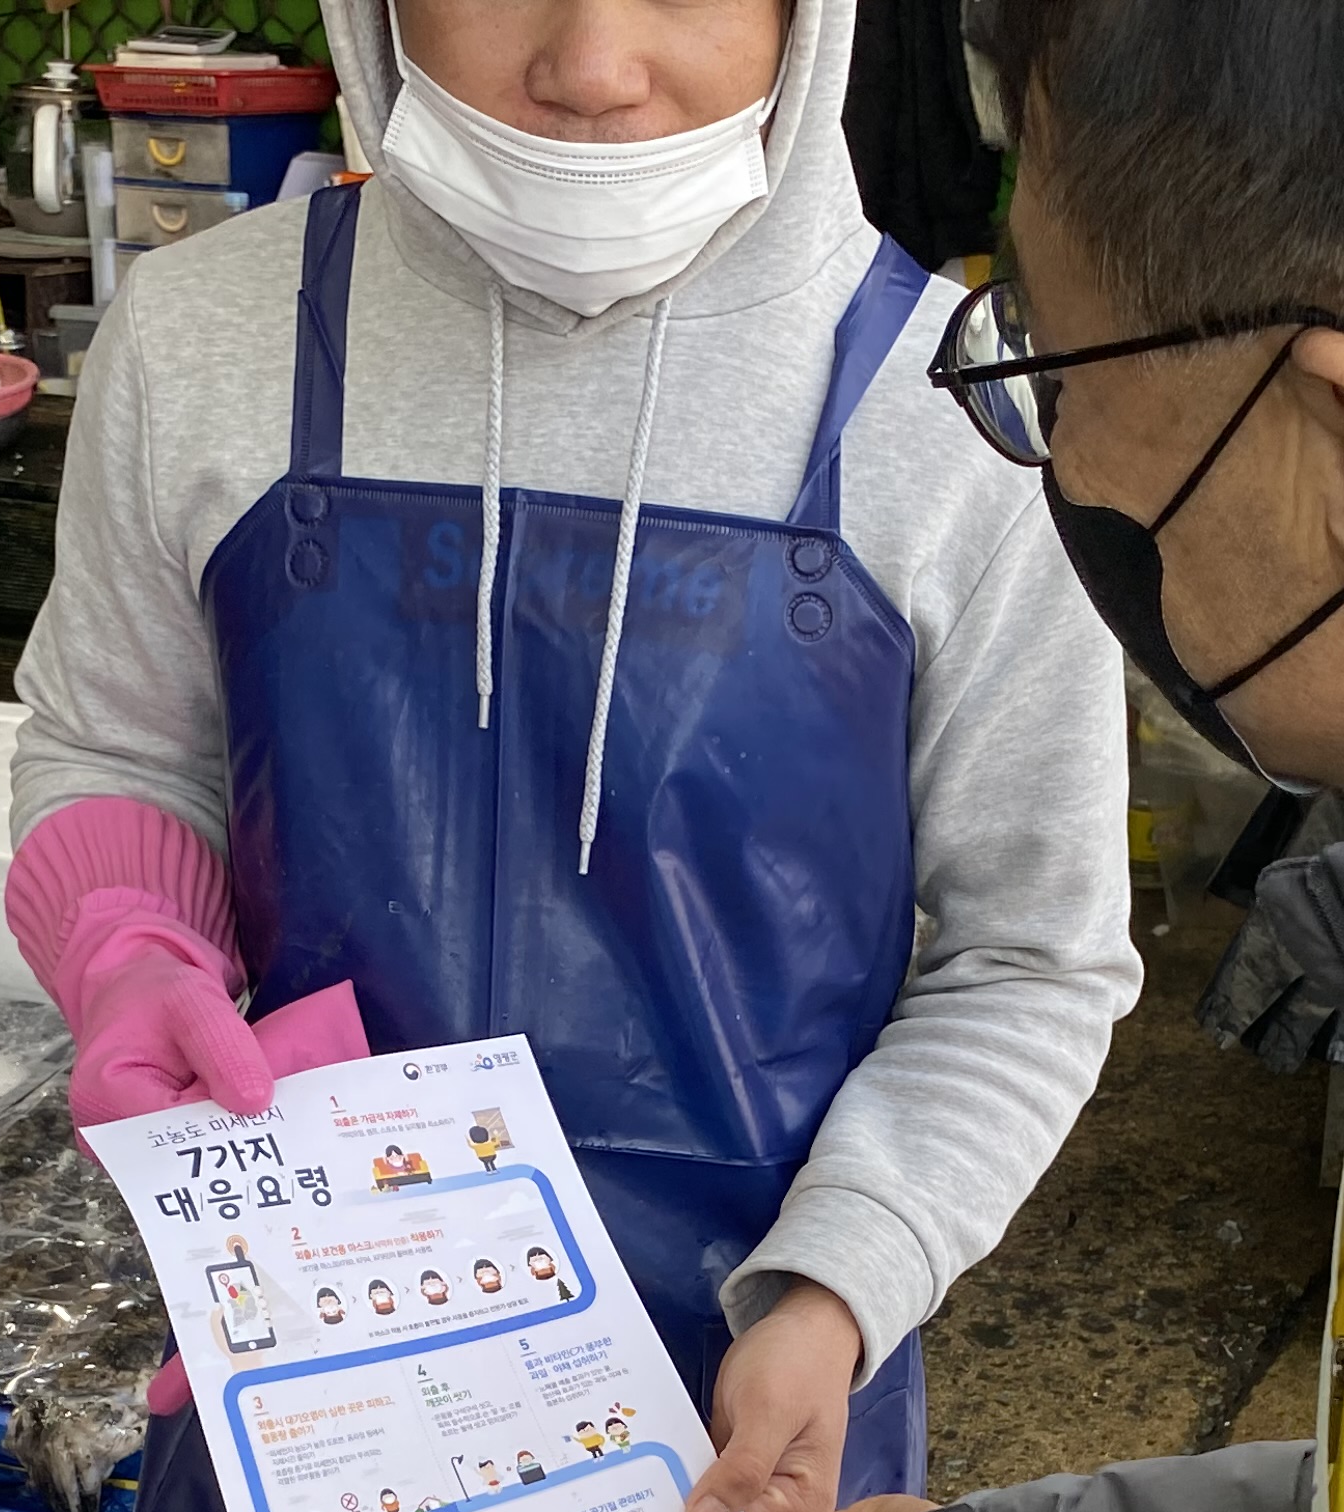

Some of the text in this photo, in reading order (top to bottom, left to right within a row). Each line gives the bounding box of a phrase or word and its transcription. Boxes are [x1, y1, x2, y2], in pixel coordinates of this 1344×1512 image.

[330, 1095, 339, 1108] 1
[147, 1105, 285, 1148] 고농도 미세먼지
[333, 1107, 419, 1127] 외출은 가급적 자제하기
[176, 1132, 285, 1178] 7가지
[291, 1227, 302, 1240] 2
[294, 1249, 321, 1261] 외출시
[322, 1244, 347, 1257] 보건용
[410, 1228, 444, 1242] 착용하기
[519, 1338, 529, 1350] 5
[544, 1346, 585, 1363] 비타민C가
[585, 1336, 612, 1352] 풍부한
[572, 1350, 609, 1368] 섭취하기
[418, 1364, 427, 1376] 4
[253, 1396, 263, 1409] 3
[425, 1394, 453, 1408] 깨끗이
[257, 1419, 284, 1431] 외출시
[285, 1409, 328, 1425] 대기오염이
[328, 1405, 346, 1418] 심한
[348, 1400, 365, 1412] 곳은
[618, 1488, 655, 1509] 관리하기
